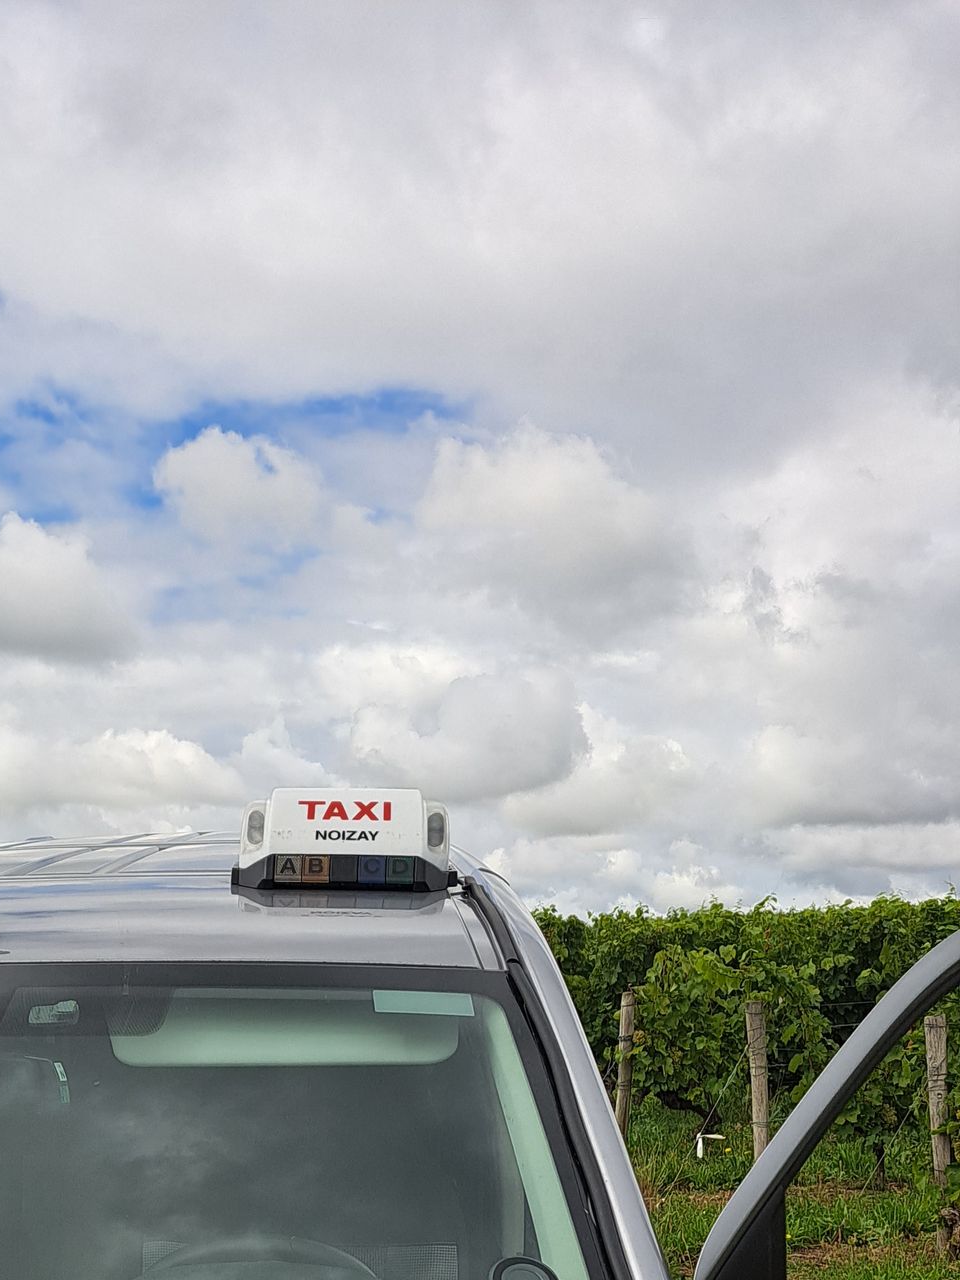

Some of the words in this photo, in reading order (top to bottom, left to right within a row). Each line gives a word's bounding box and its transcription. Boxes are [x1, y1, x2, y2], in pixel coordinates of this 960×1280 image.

[298, 800, 392, 821] TAXI
[315, 829, 379, 842] NOIZAY
[279, 857, 297, 874] A
[308, 857, 324, 874] B
